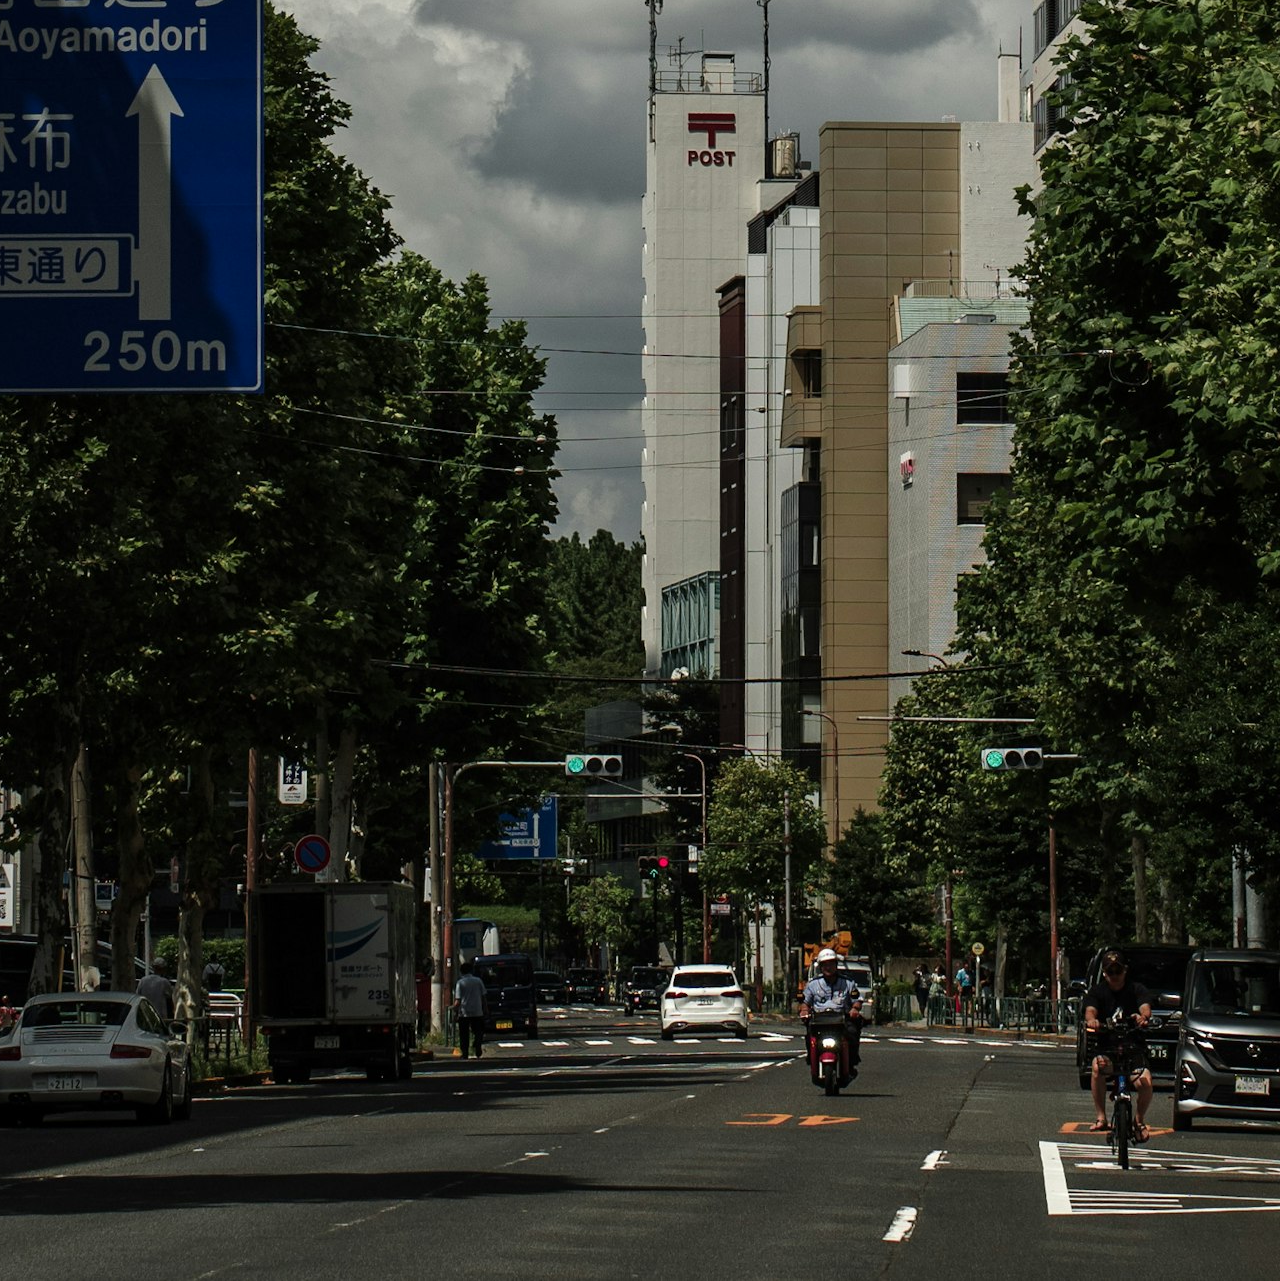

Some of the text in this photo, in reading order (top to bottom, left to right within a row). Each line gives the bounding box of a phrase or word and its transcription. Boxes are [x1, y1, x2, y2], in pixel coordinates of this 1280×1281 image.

[688, 150, 736, 167] POST
[83, 331, 227, 372] 250m
[368, 989, 390, 1000] 235
[55, 1079, 81, 1089] 21-12
